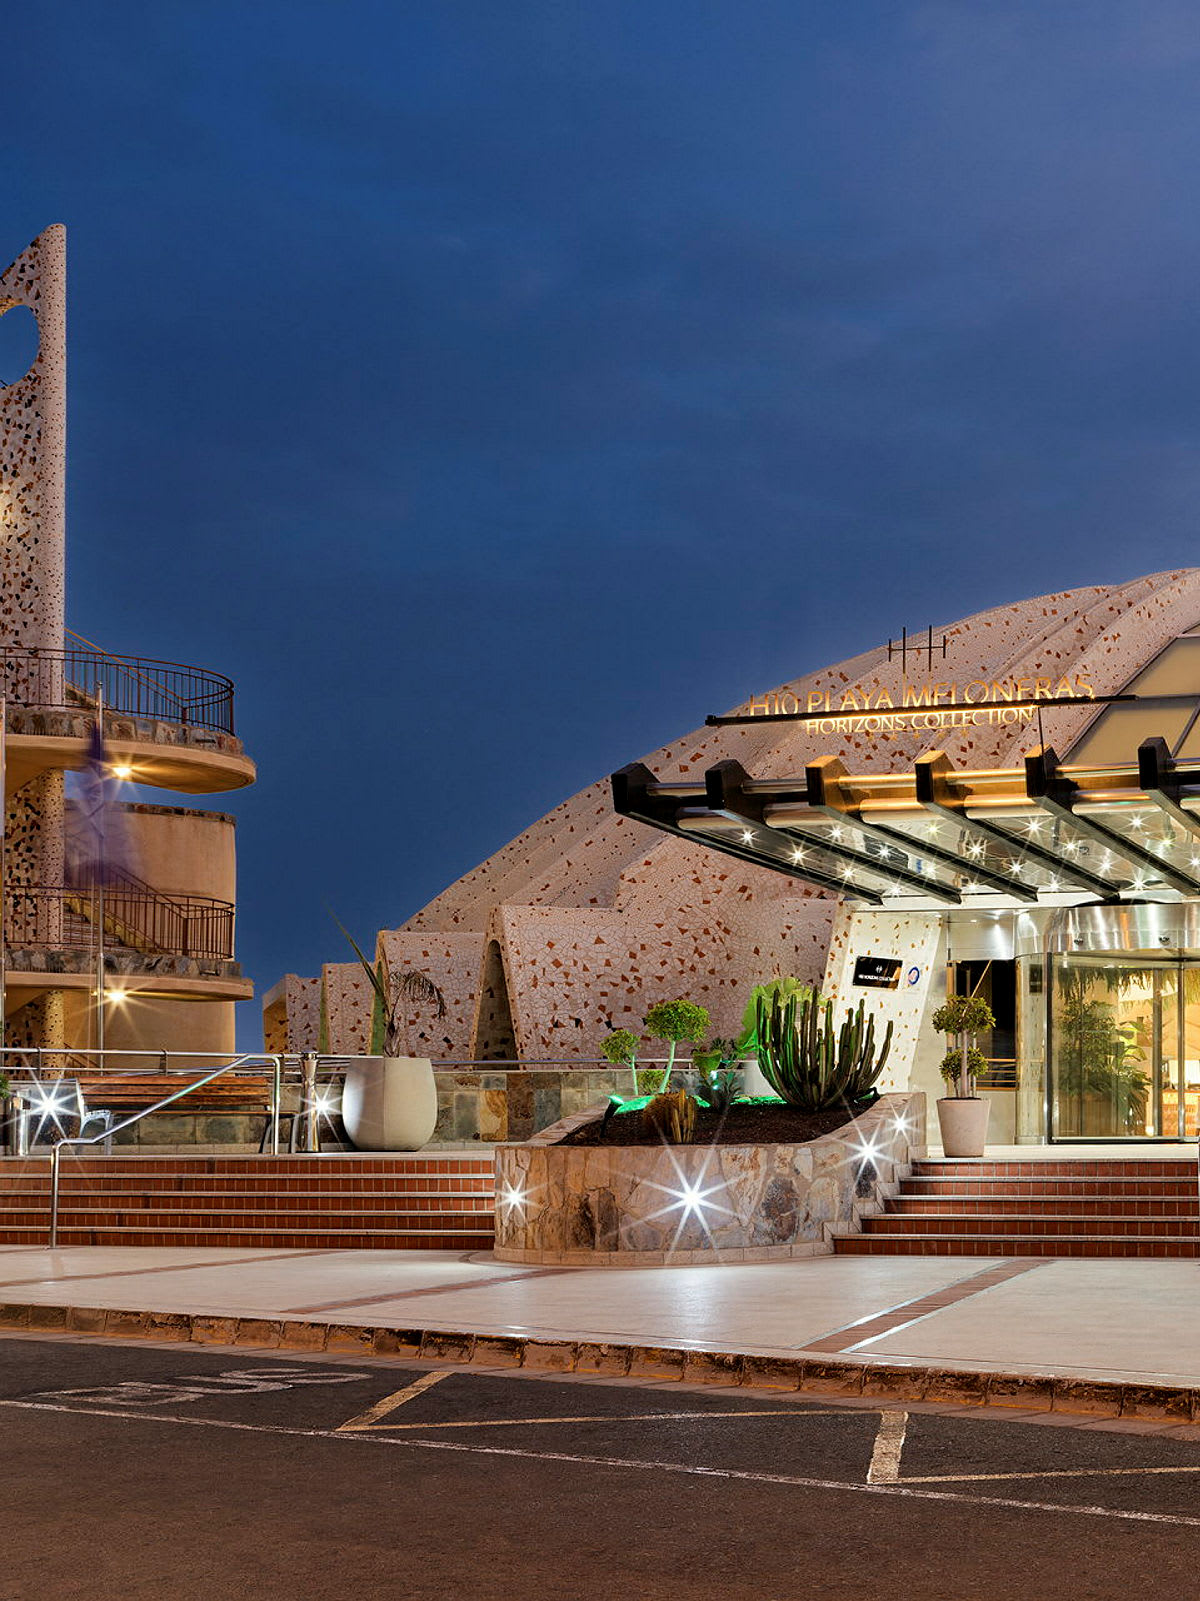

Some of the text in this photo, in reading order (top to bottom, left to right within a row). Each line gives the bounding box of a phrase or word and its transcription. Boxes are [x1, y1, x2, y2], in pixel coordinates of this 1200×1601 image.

[749, 673, 1094, 717] H10 PLAYA MELONERAS
[806, 708, 1034, 735] HORIZONS COLLECTION
